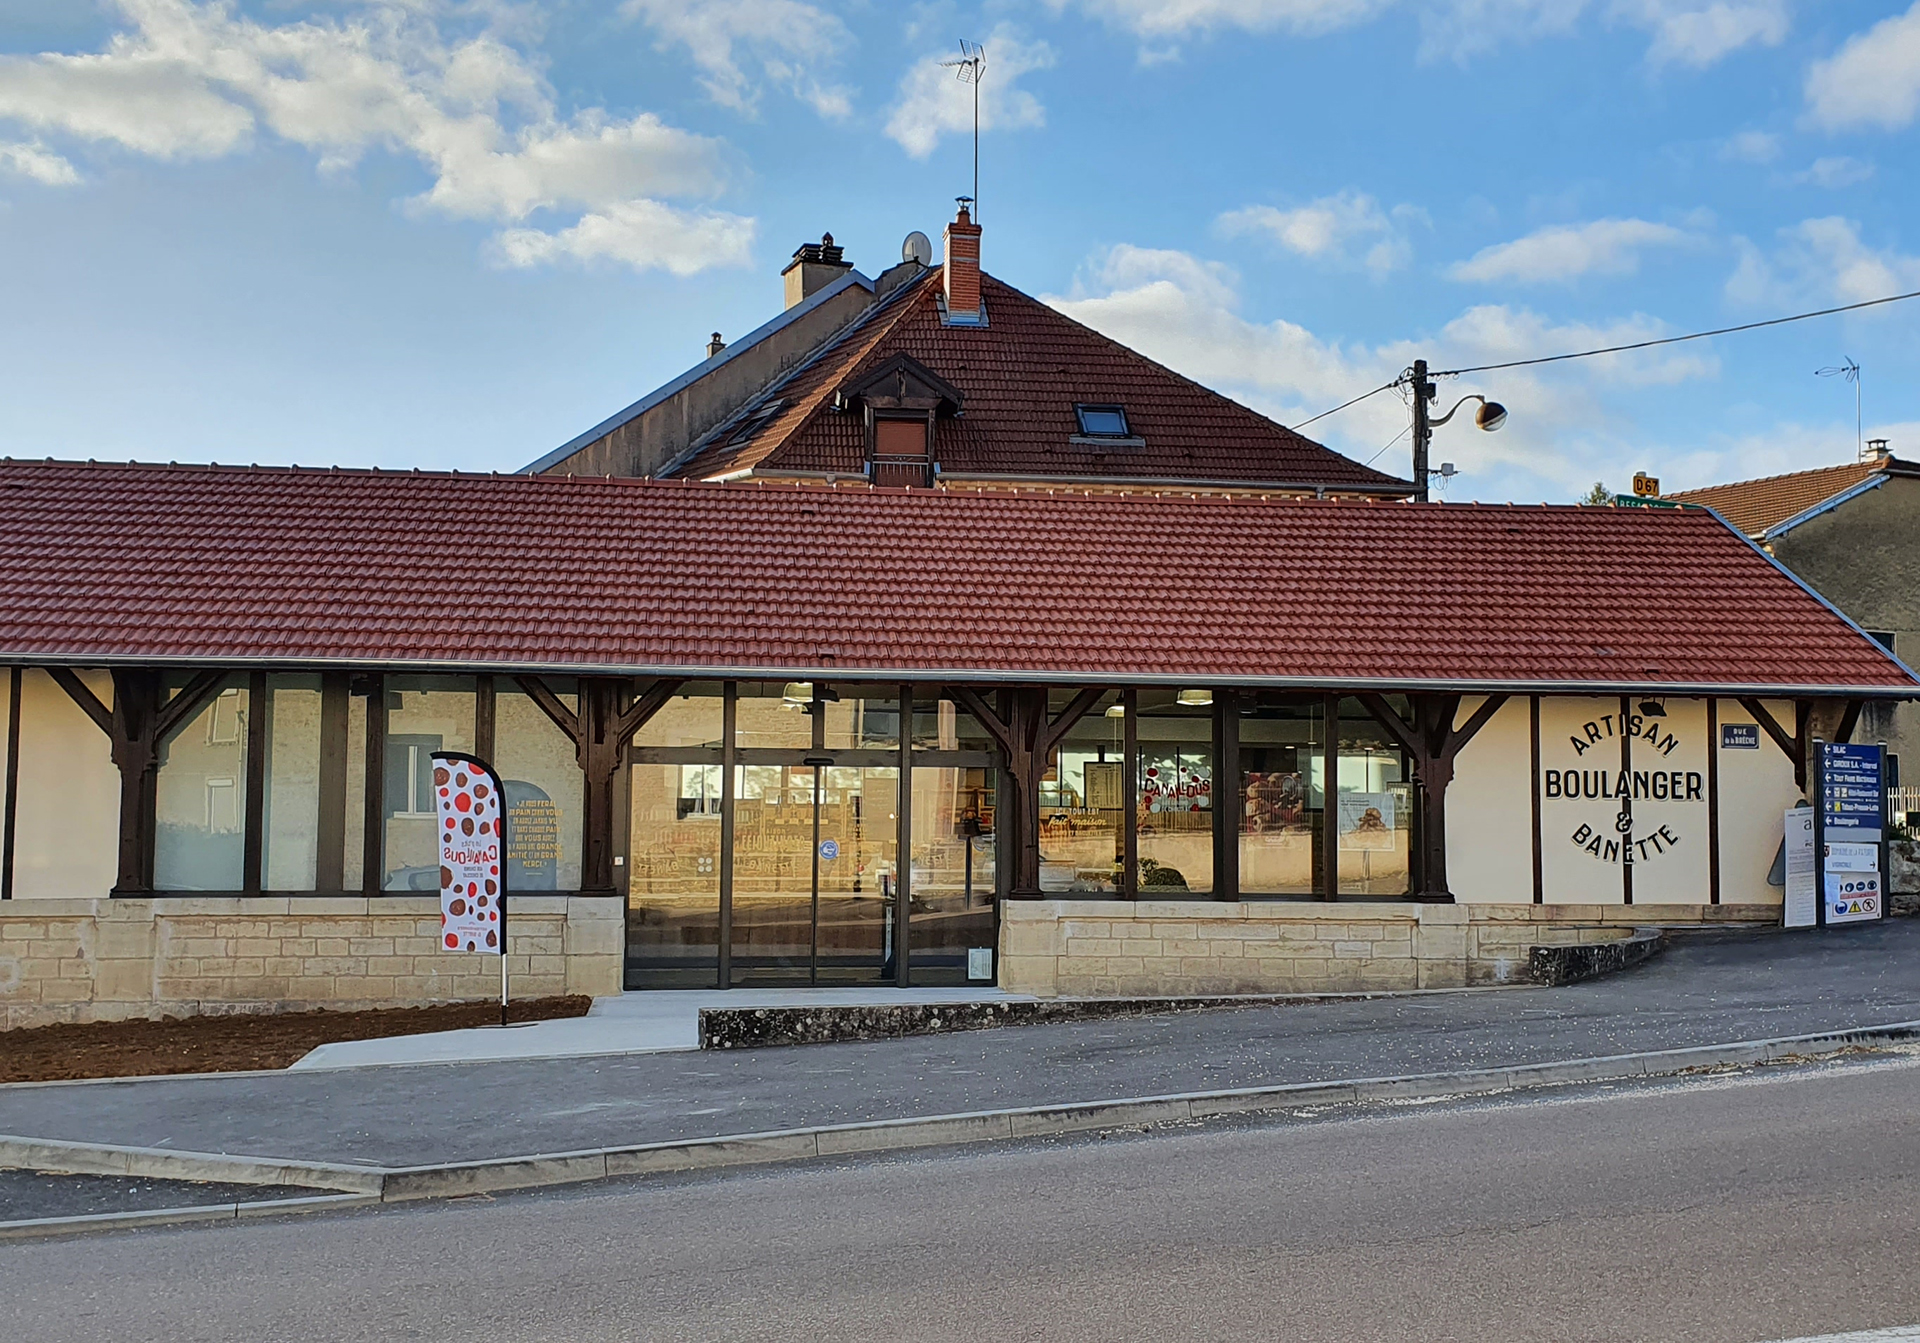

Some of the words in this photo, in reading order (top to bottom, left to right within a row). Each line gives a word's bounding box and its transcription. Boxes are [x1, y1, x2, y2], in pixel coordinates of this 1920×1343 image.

[1636, 479, 1643, 491] D
[1645, 480, 1658, 493] 67
[1570, 713, 1679, 757] ARTISAN
[1144, 778, 1210, 799] CANAILLOUS
[1546, 770, 1703, 800] BOULANGER
[1047, 815, 1068, 828] fait
[1070, 816, 1107, 826] maison
[1616, 811, 1633, 833] &
[1572, 823, 1679, 863] BANETTE
